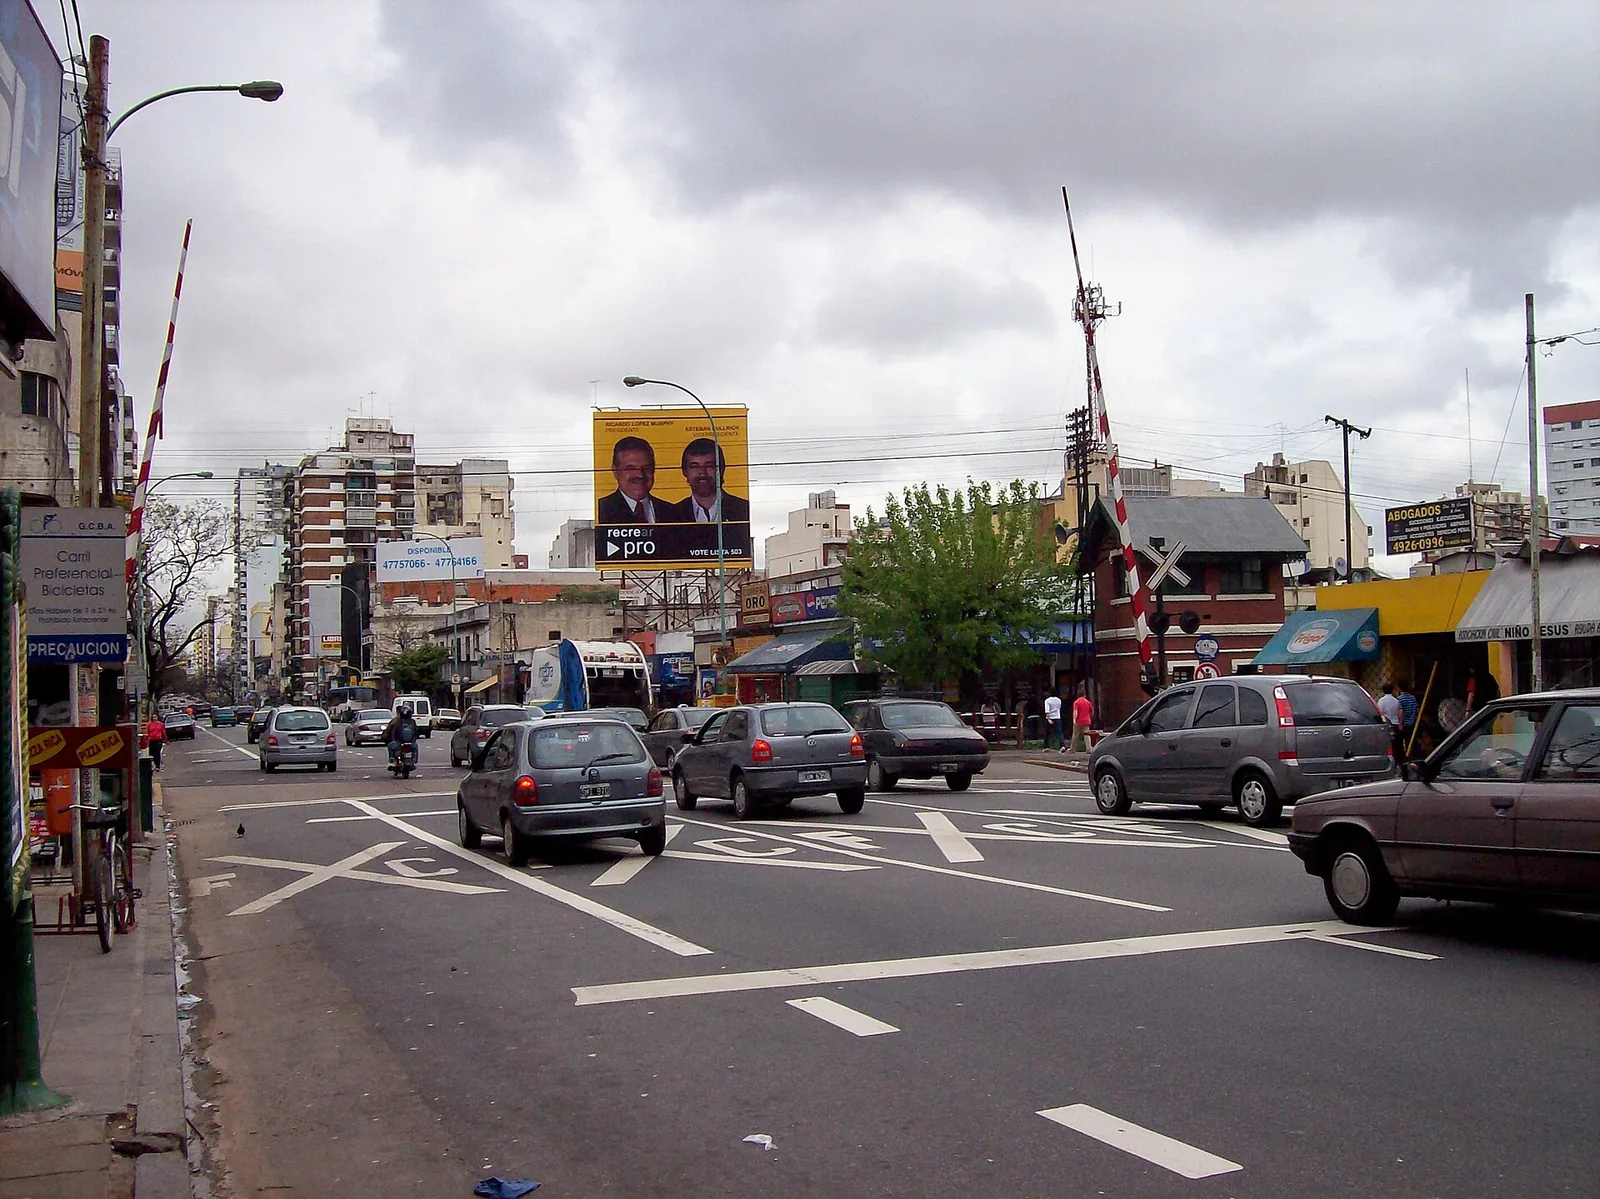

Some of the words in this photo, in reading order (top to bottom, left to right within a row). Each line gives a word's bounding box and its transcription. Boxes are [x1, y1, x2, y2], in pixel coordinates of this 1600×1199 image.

[1388, 505, 1442, 522] ABOGADOS
[78, 523, 116, 531] G.C.B.A.
[607, 528, 654, 538] recrear
[624, 541, 656, 559] pro
[1393, 537, 1444, 552] 4926-0996
[57, 550, 91, 563] Carril
[34, 567, 113, 580] Preferencial
[42, 584, 105, 597] Bicicletas
[746, 596, 765, 609] ORO
[1540, 624, 1569, 636] ESUS
[28, 642, 120, 656] PRECAUCION
[79, 744, 102, 761] PIZZA
[101, 734, 120, 750] RICA
